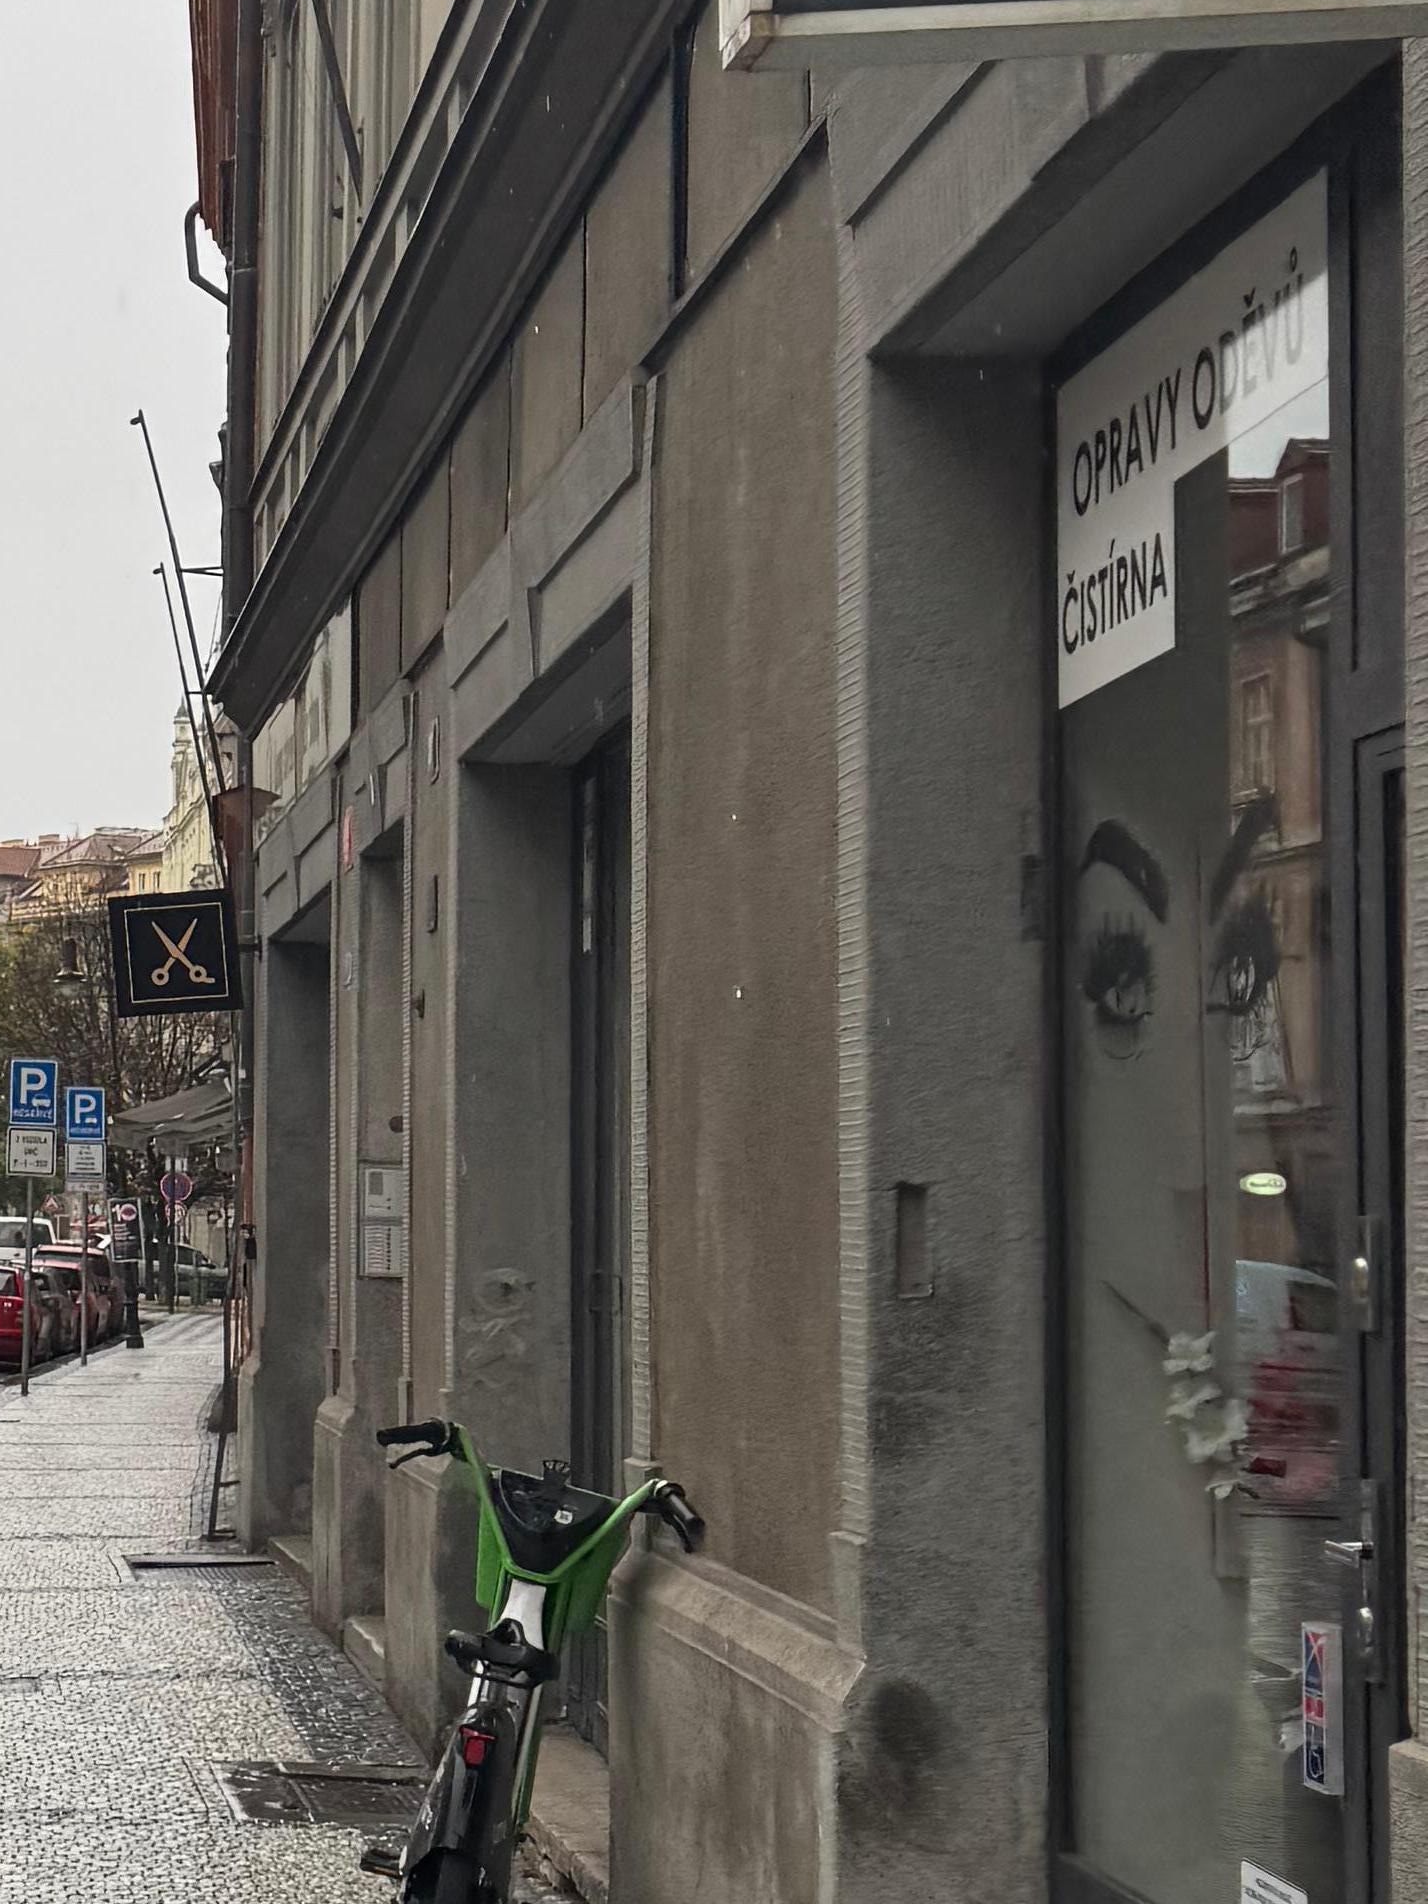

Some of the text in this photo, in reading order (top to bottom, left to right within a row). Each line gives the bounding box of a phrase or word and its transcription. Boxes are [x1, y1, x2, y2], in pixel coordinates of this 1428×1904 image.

[1071, 246, 1305, 518] OPRAVY ODĚVŮ
[1061, 532, 1169, 655] ČISTÍRNA
[20, 1067, 47, 1104] P
[75, 1094, 96, 1124] P
